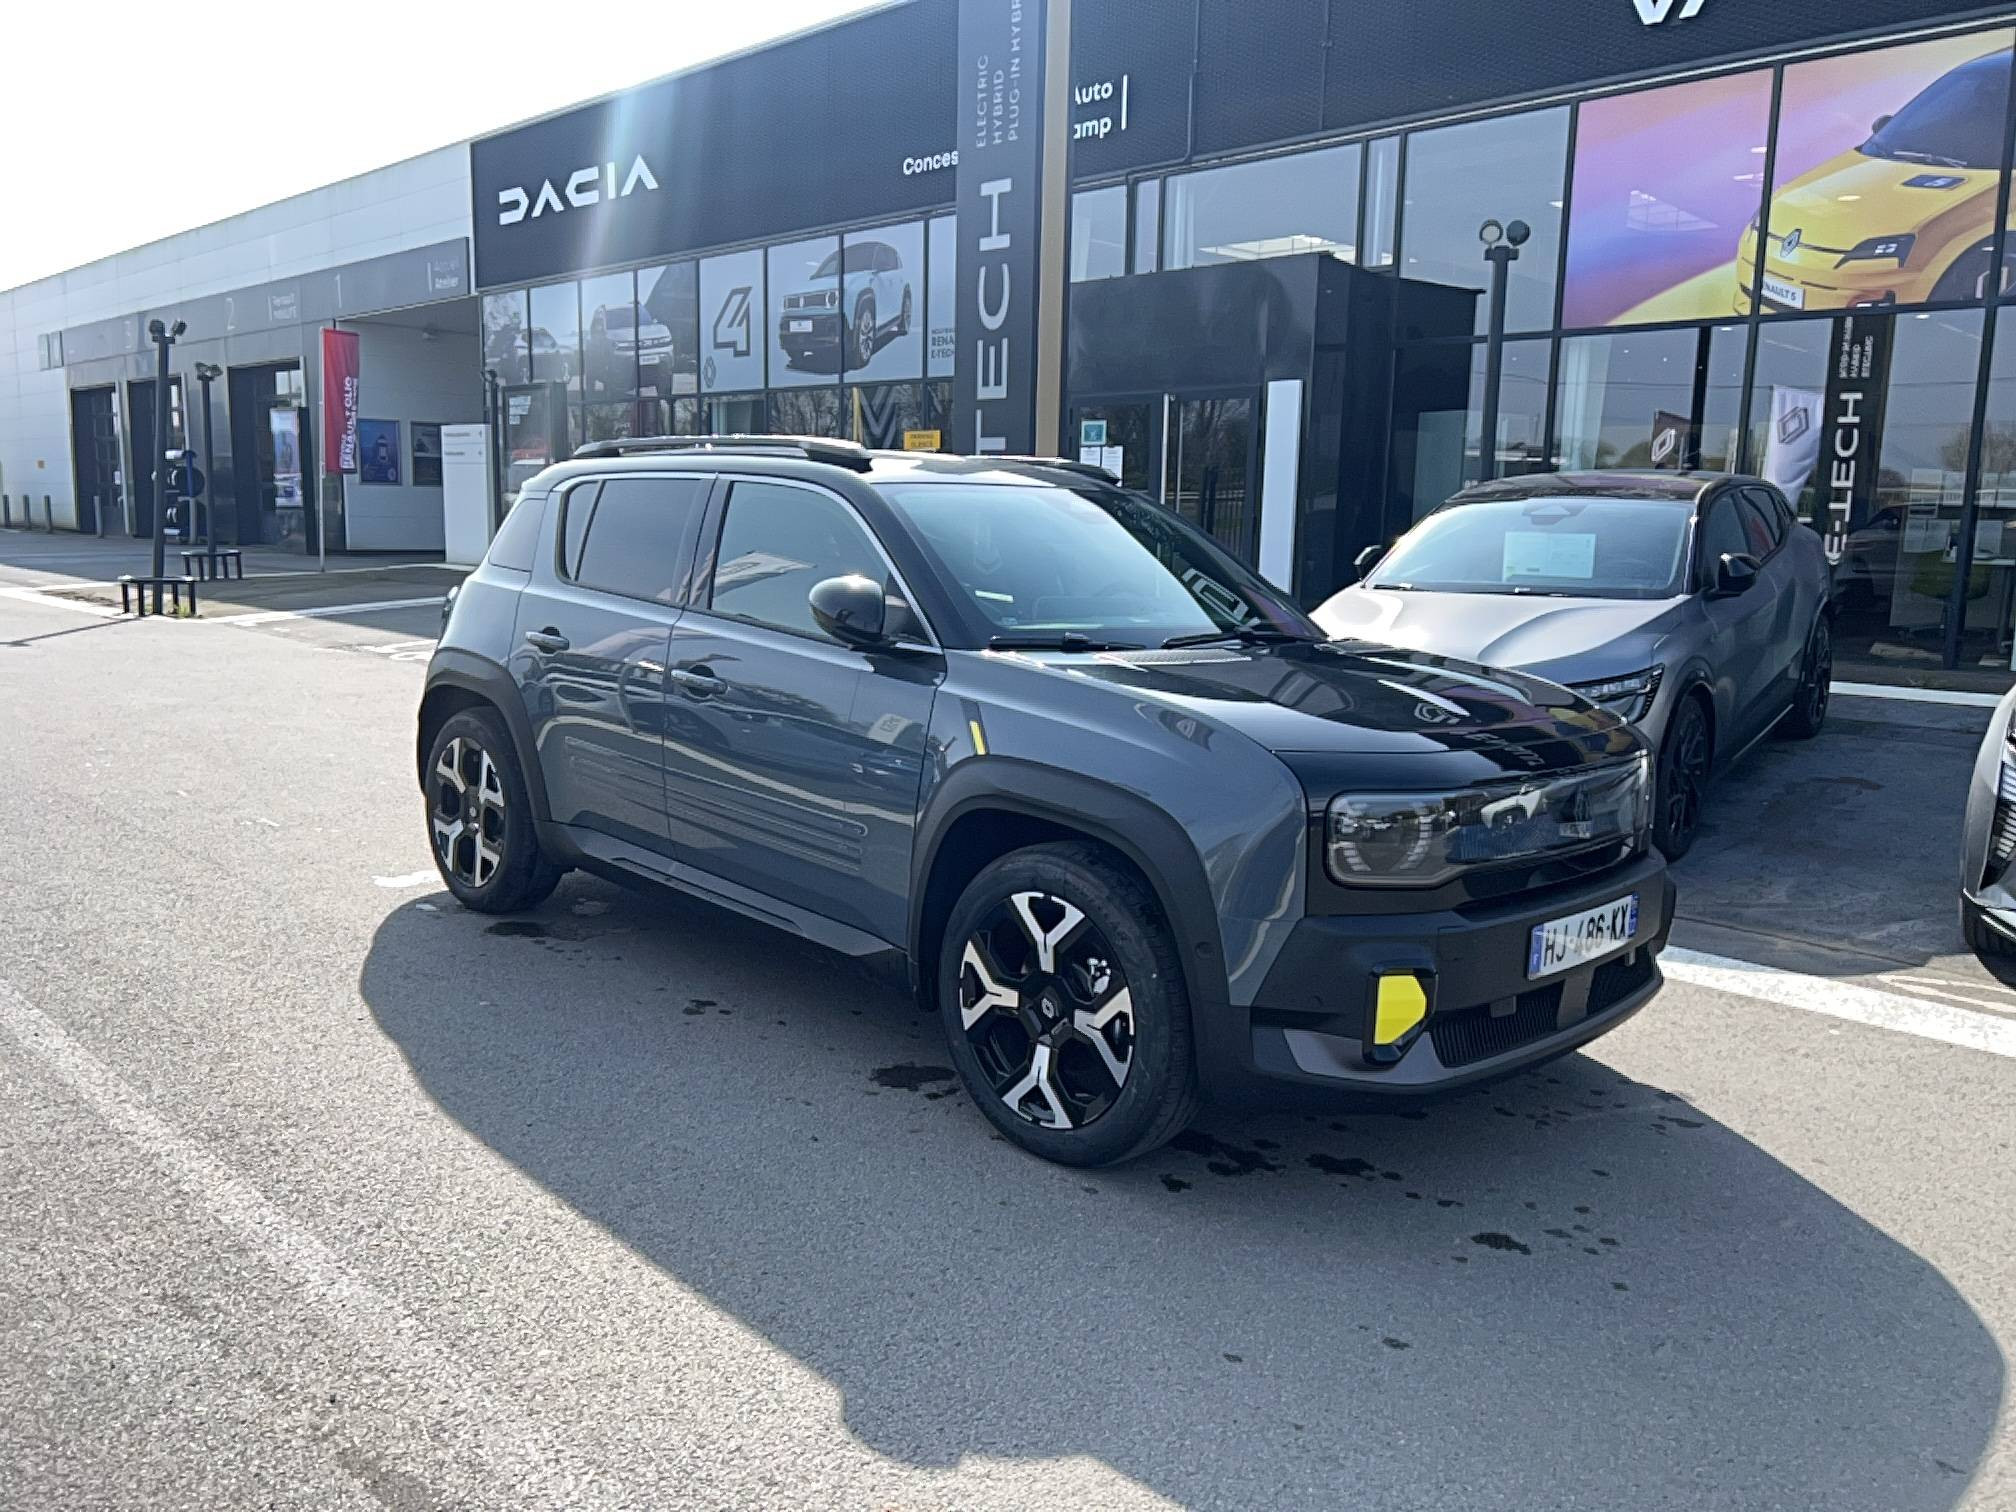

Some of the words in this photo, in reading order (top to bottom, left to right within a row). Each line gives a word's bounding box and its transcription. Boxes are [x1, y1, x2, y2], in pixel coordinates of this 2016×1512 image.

[976, 54, 989, 149] ELECTRIC
[993, 69, 1005, 145] HYBRID
[1008, 57, 1021, 141] PLUG-IN
[498, 153, 659, 226] DACIA
[903, 150, 959, 175] Conces
[713, 286, 752, 358] 4
[1824, 392, 1864, 565] E-TECH
